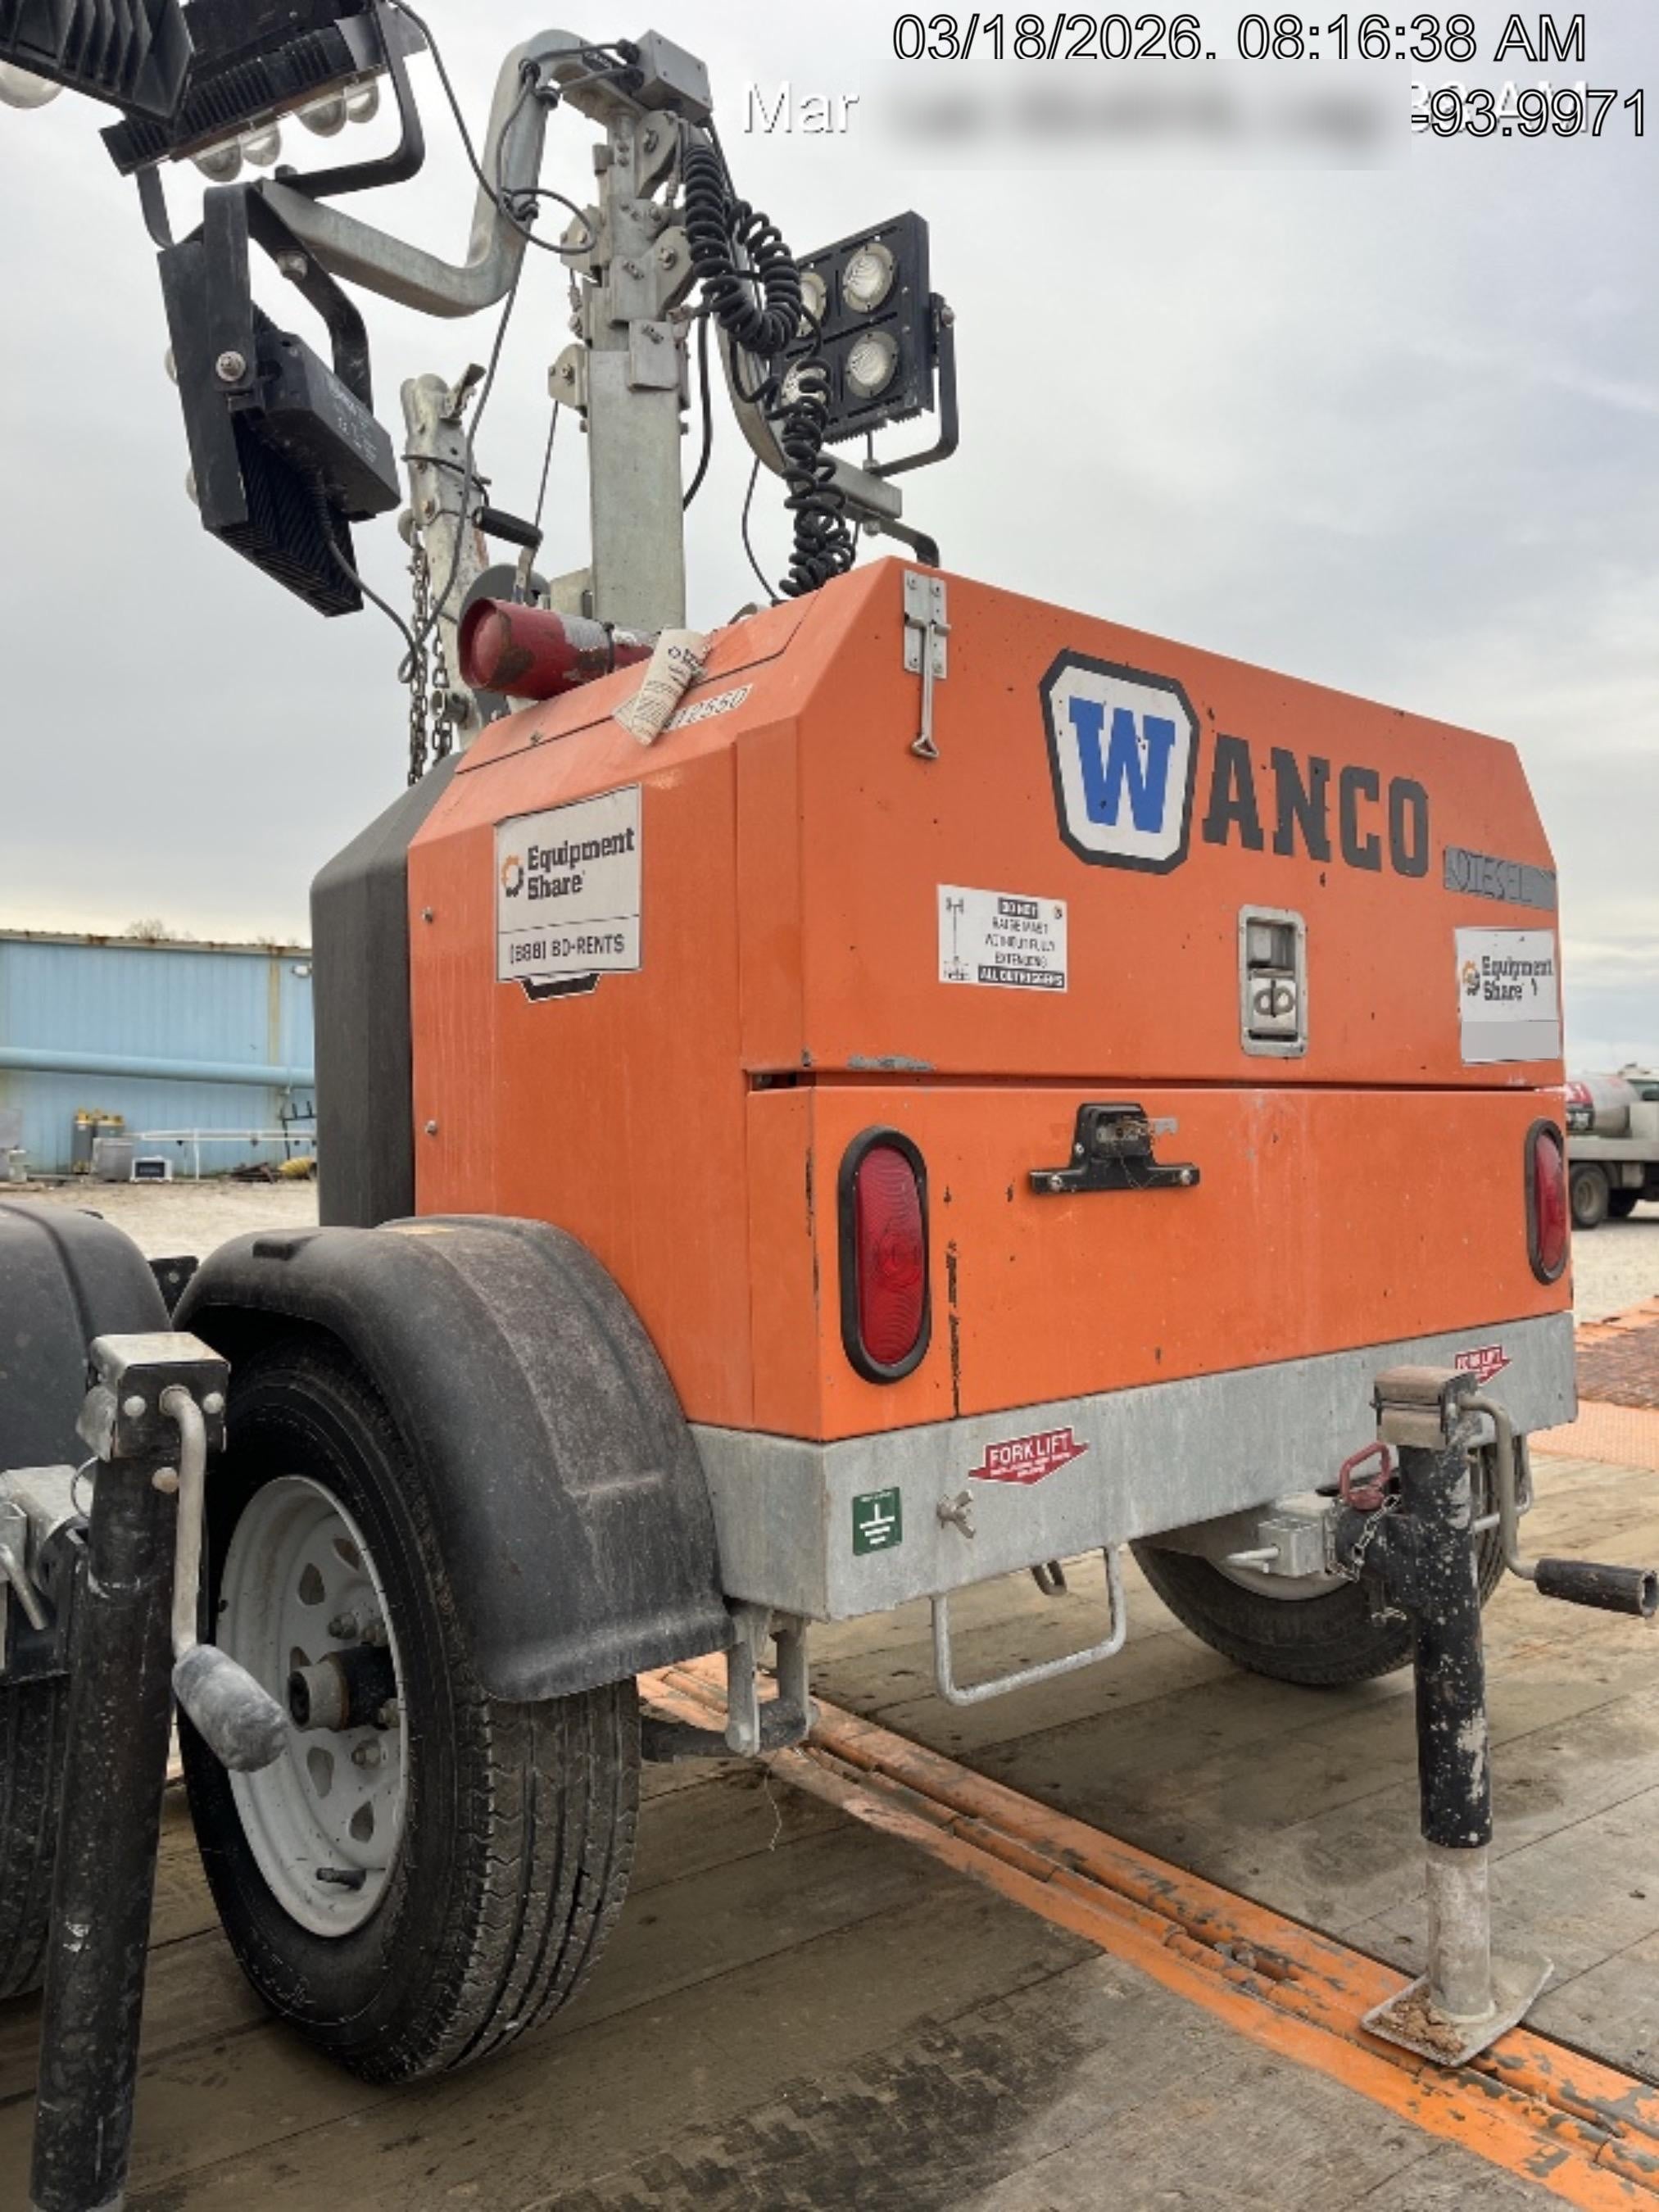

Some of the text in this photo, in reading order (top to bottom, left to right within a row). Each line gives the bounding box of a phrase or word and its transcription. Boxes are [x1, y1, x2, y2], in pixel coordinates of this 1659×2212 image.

[1068, 695, 1430, 878] WANCO
[528, 827, 635, 873] Equipment
[528, 873, 583, 900] Share
[1481, 955, 1553, 981] Equipment
[1484, 980, 1523, 1001] Share
